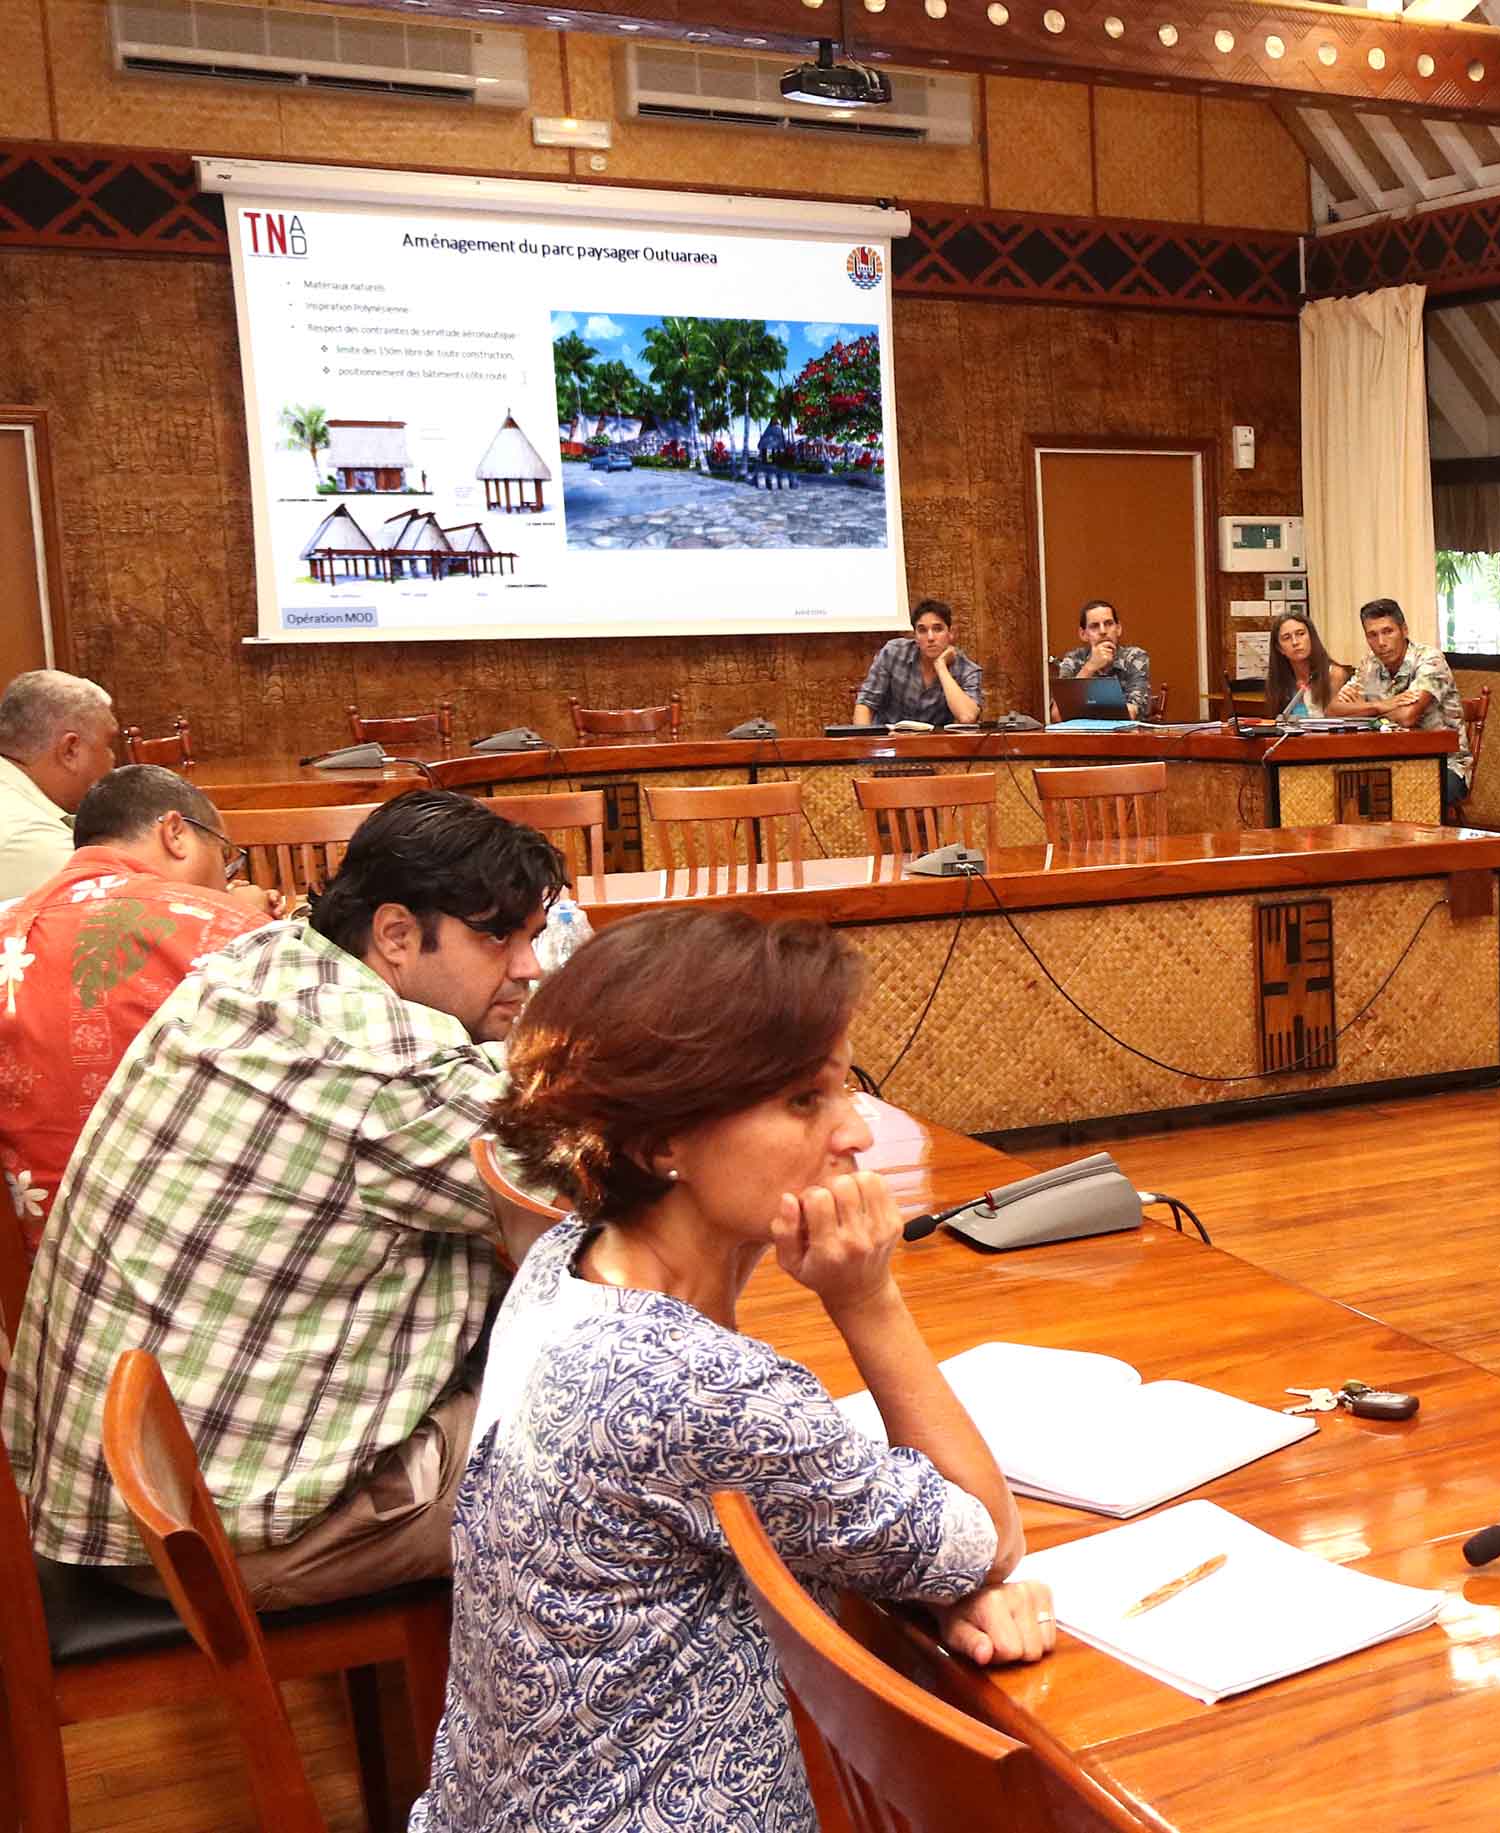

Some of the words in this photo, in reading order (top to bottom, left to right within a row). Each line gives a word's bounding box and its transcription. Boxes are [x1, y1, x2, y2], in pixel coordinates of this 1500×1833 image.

[403, 232, 515, 254] Aménagement
[518, 238, 538, 254] du
[541, 243, 574, 258] parc
[577, 245, 640, 263] paysager
[643, 246, 718, 265] Outuaraea
[411, 328, 420, 337] de
[287, 612, 343, 626] Opération
[344, 612, 374, 624] MOD
